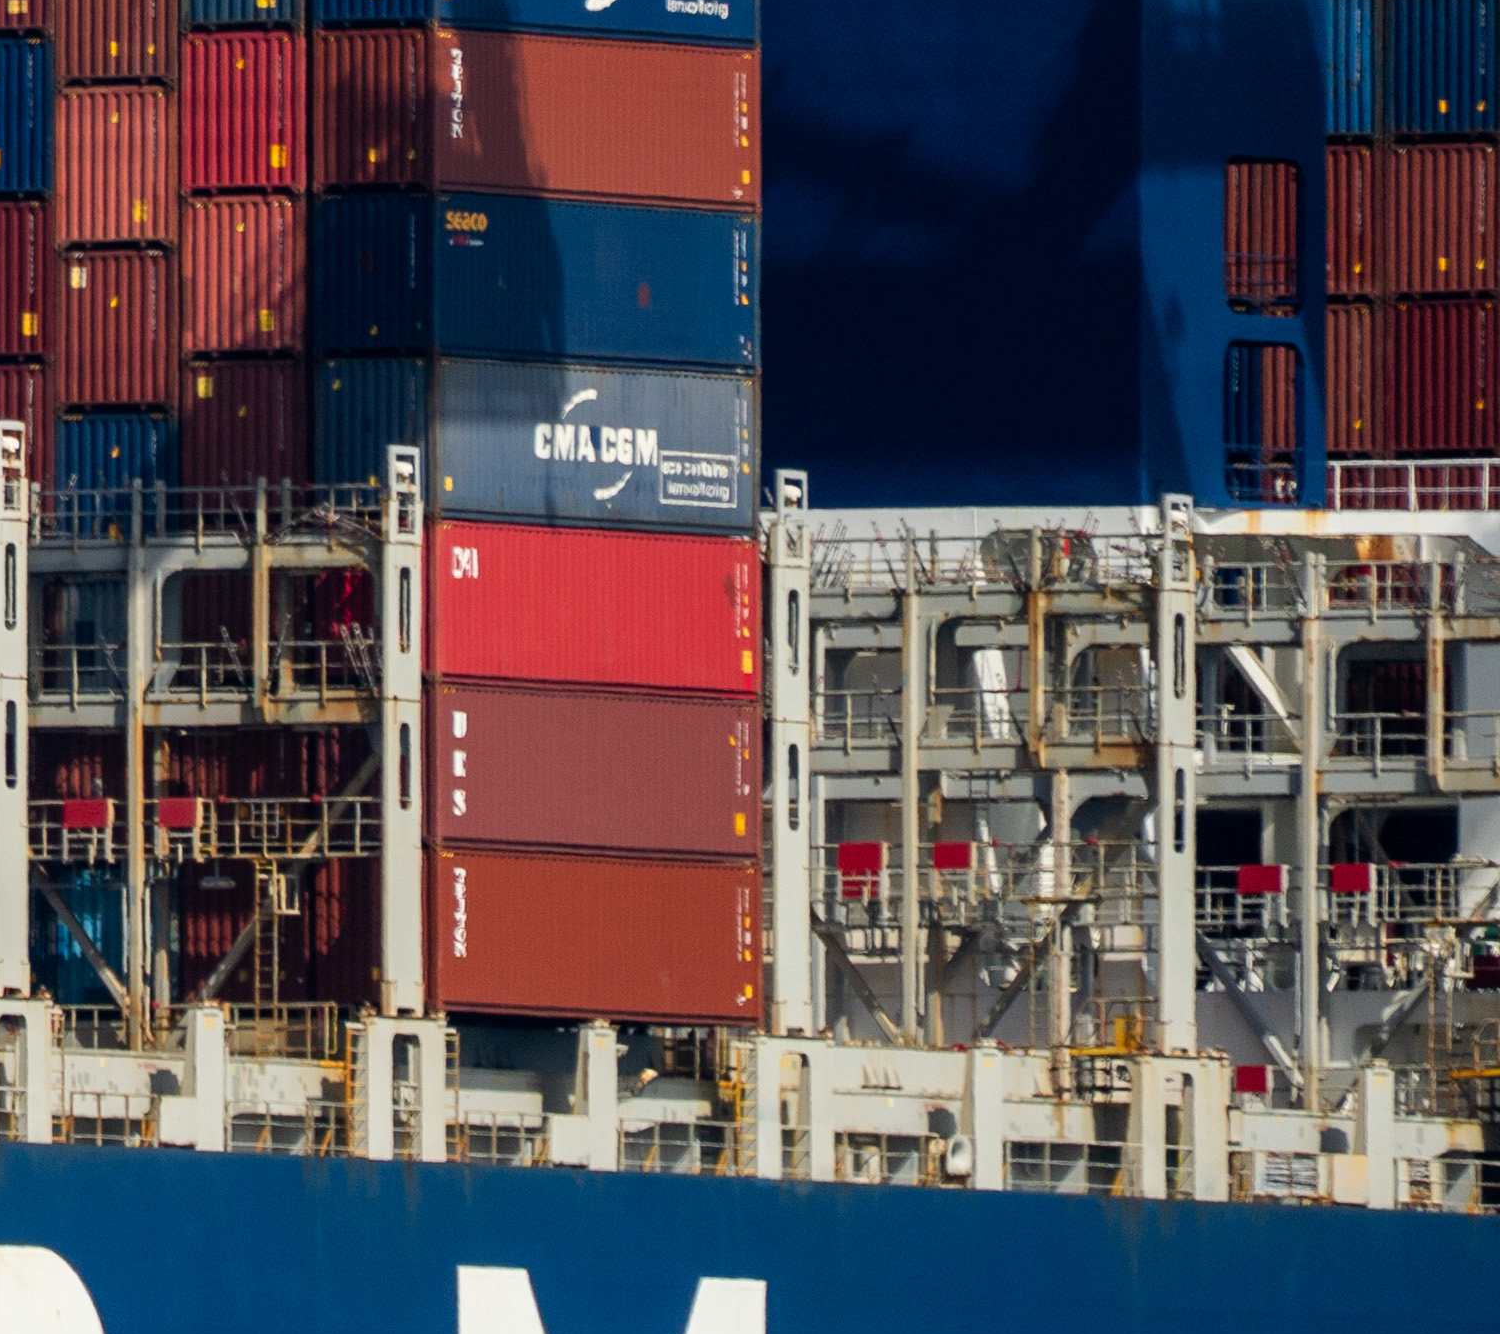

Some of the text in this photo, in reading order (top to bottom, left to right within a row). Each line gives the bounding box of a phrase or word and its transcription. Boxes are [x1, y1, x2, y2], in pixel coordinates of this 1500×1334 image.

[444, 210, 489, 234] seaco
[534, 422, 660, 467] CMA CGM
